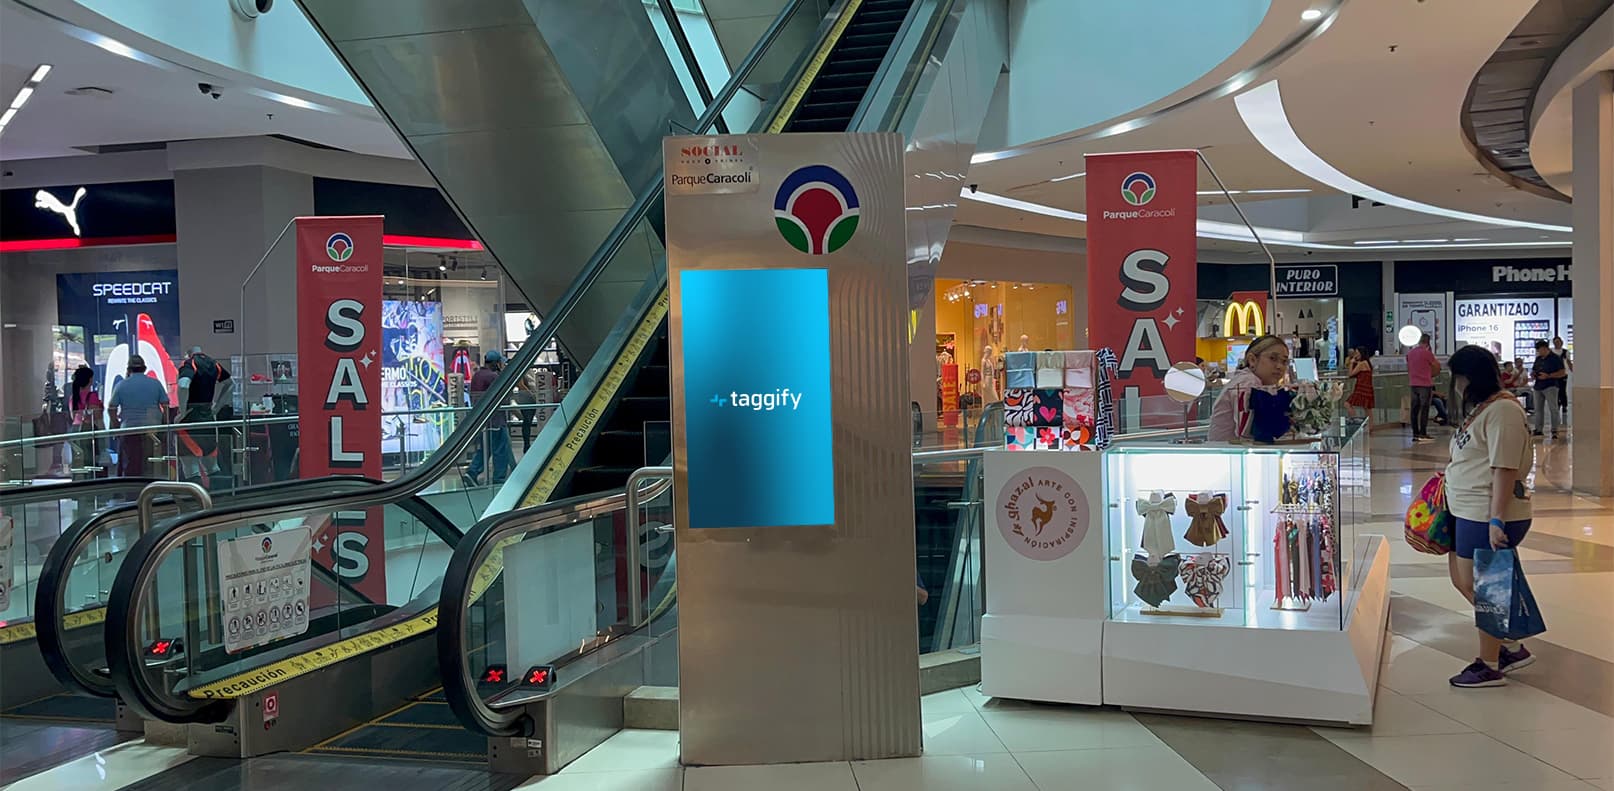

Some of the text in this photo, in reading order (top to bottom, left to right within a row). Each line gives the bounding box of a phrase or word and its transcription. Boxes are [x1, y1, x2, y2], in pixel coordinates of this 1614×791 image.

[1286, 269, 1321, 280] PURO
[92, 282, 172, 296] SPEEDCAT
[1276, 281, 1334, 292] INTERIOR
[1458, 302, 1539, 317] GARANTIZADO
[1457, 324, 1487, 332] iPhone
[730, 388, 802, 410] taggify
[325, 299, 369, 580] SALS
[566, 408, 599, 451] Precaución
[1004, 476, 1034, 521] ghazal
[1038, 480, 1063, 492] ARTE
[1064, 492, 1077, 512] CON
[203, 668, 287, 698] Precaución
